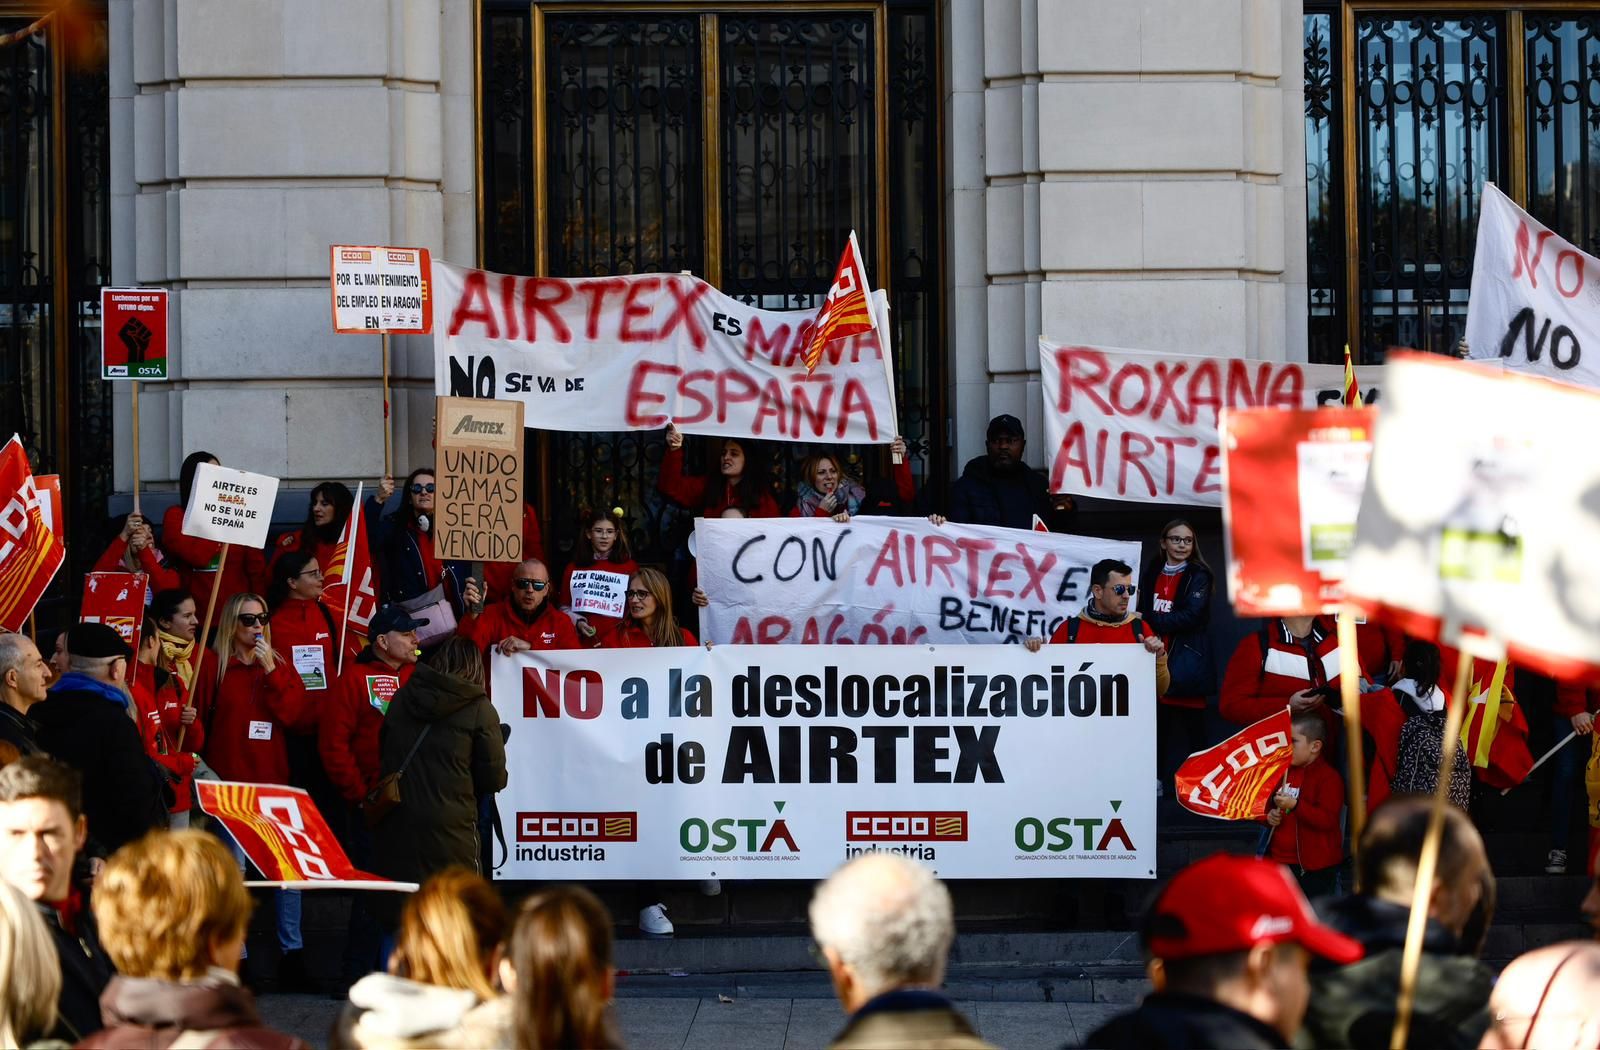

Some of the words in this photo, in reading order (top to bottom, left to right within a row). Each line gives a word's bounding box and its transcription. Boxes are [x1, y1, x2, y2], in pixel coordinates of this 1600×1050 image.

[1513, 219, 1585, 299] NO
[336, 273, 351, 286] POR
[354, 273, 363, 286] EL
[364, 273, 419, 288] MANTENIMIENTO
[111, 294, 141, 302] Luchemos
[141, 295, 151, 303] por
[117, 303, 137, 311] FUTURO
[336, 295, 350, 308] DEL
[351, 295, 379, 308] EMPLEO
[381, 296, 392, 309] EN
[392, 296, 421, 309] ARAGON
[365, 316, 380, 328] EN
[447, 270, 711, 354] AIRTEX
[713, 311, 743, 336] ES
[1501, 306, 1582, 371] NO
[449, 355, 496, 399] NO
[504, 372, 533, 393] SE
[537, 376, 556, 393] VA
[565, 377, 585, 392] DE
[624, 359, 880, 441] ESPAÑA
[1054, 346, 1305, 428] ROXANA
[211, 480, 247, 494] AIRTEX
[247, 486, 258, 496] ES
[441, 475, 518, 504] JAMAS
[204, 503, 217, 512] NO
[218, 505, 232, 515] SE
[234, 508, 244, 517] VA
[245, 510, 257, 519] DE
[211, 516, 244, 529] ESPAÑA
[445, 502, 509, 531] SERA
[731, 528, 852, 583] CON
[865, 529, 1058, 602] AIRTEX
[1056, 566, 1092, 602] E
[939, 596, 1075, 635] BENEFIC
[521, 666, 604, 720] NO
[620, 676, 650, 720] a
[668, 667, 713, 718] la
[731, 661, 1130, 718] deslocalización
[645, 733, 706, 785] de
[721, 725, 1005, 784] AIRTEX
[522, 817, 599, 836] CCOO
[852, 817, 929, 836] CCOO
[515, 844, 606, 861] industria
